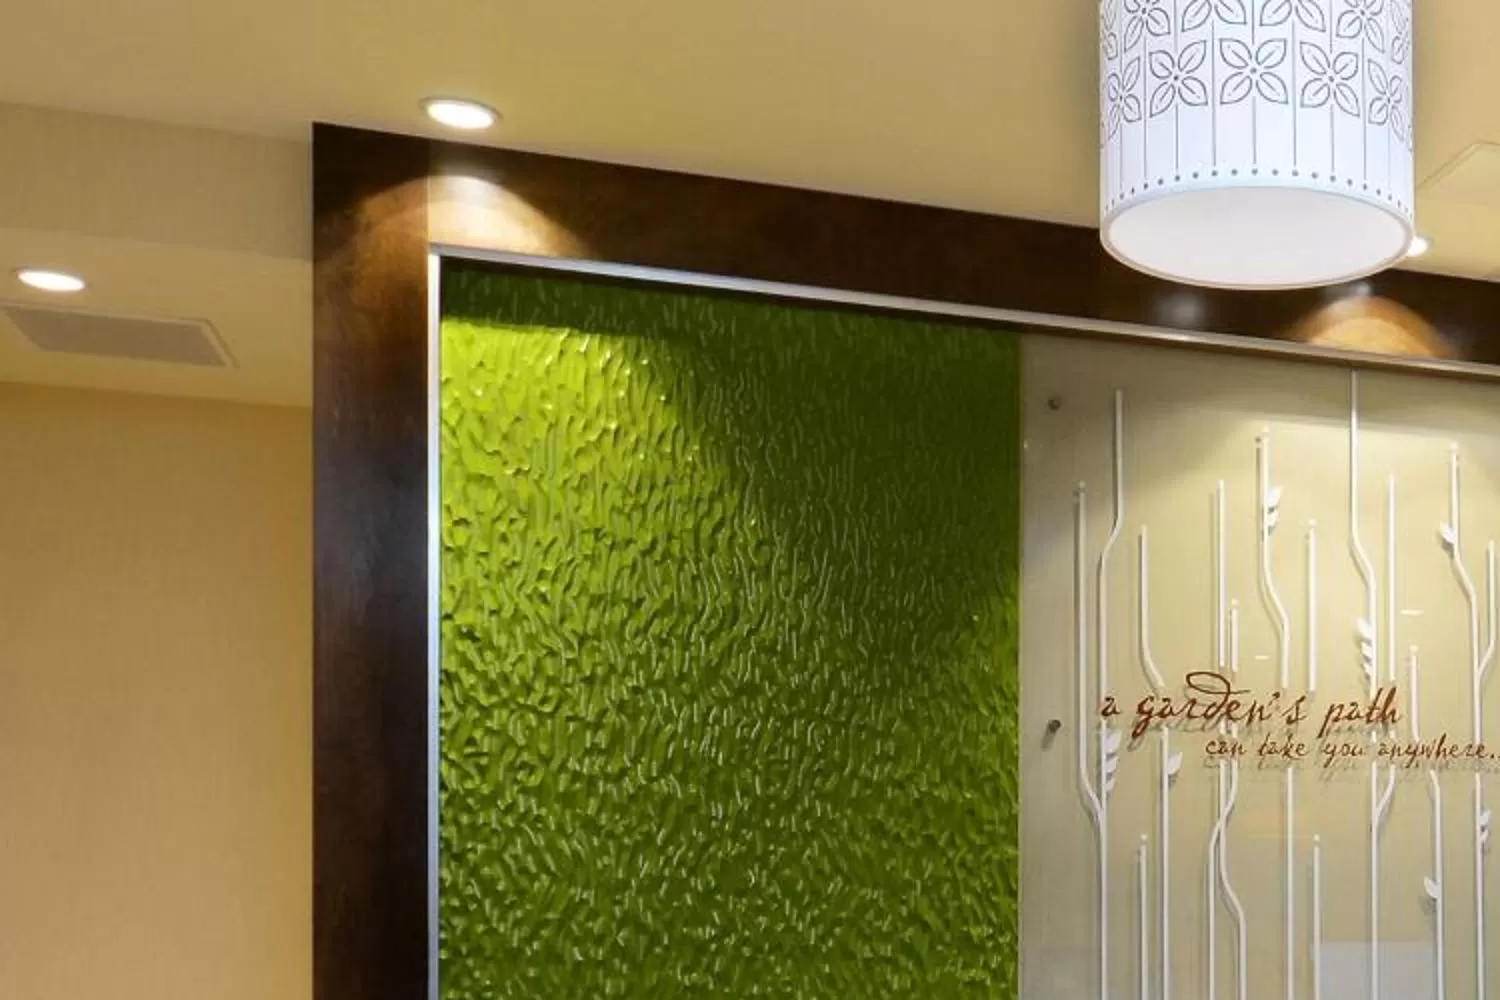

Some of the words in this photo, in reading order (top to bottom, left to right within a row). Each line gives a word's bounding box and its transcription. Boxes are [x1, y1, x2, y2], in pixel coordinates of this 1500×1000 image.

[1101, 697, 1121, 716] a
[1132, 672, 1306, 738] garden's
[1318, 686, 1402, 738] path
[1206, 740, 1247, 757] can
[1259, 732, 1309, 759] take
[1323, 742, 1367, 768] you
